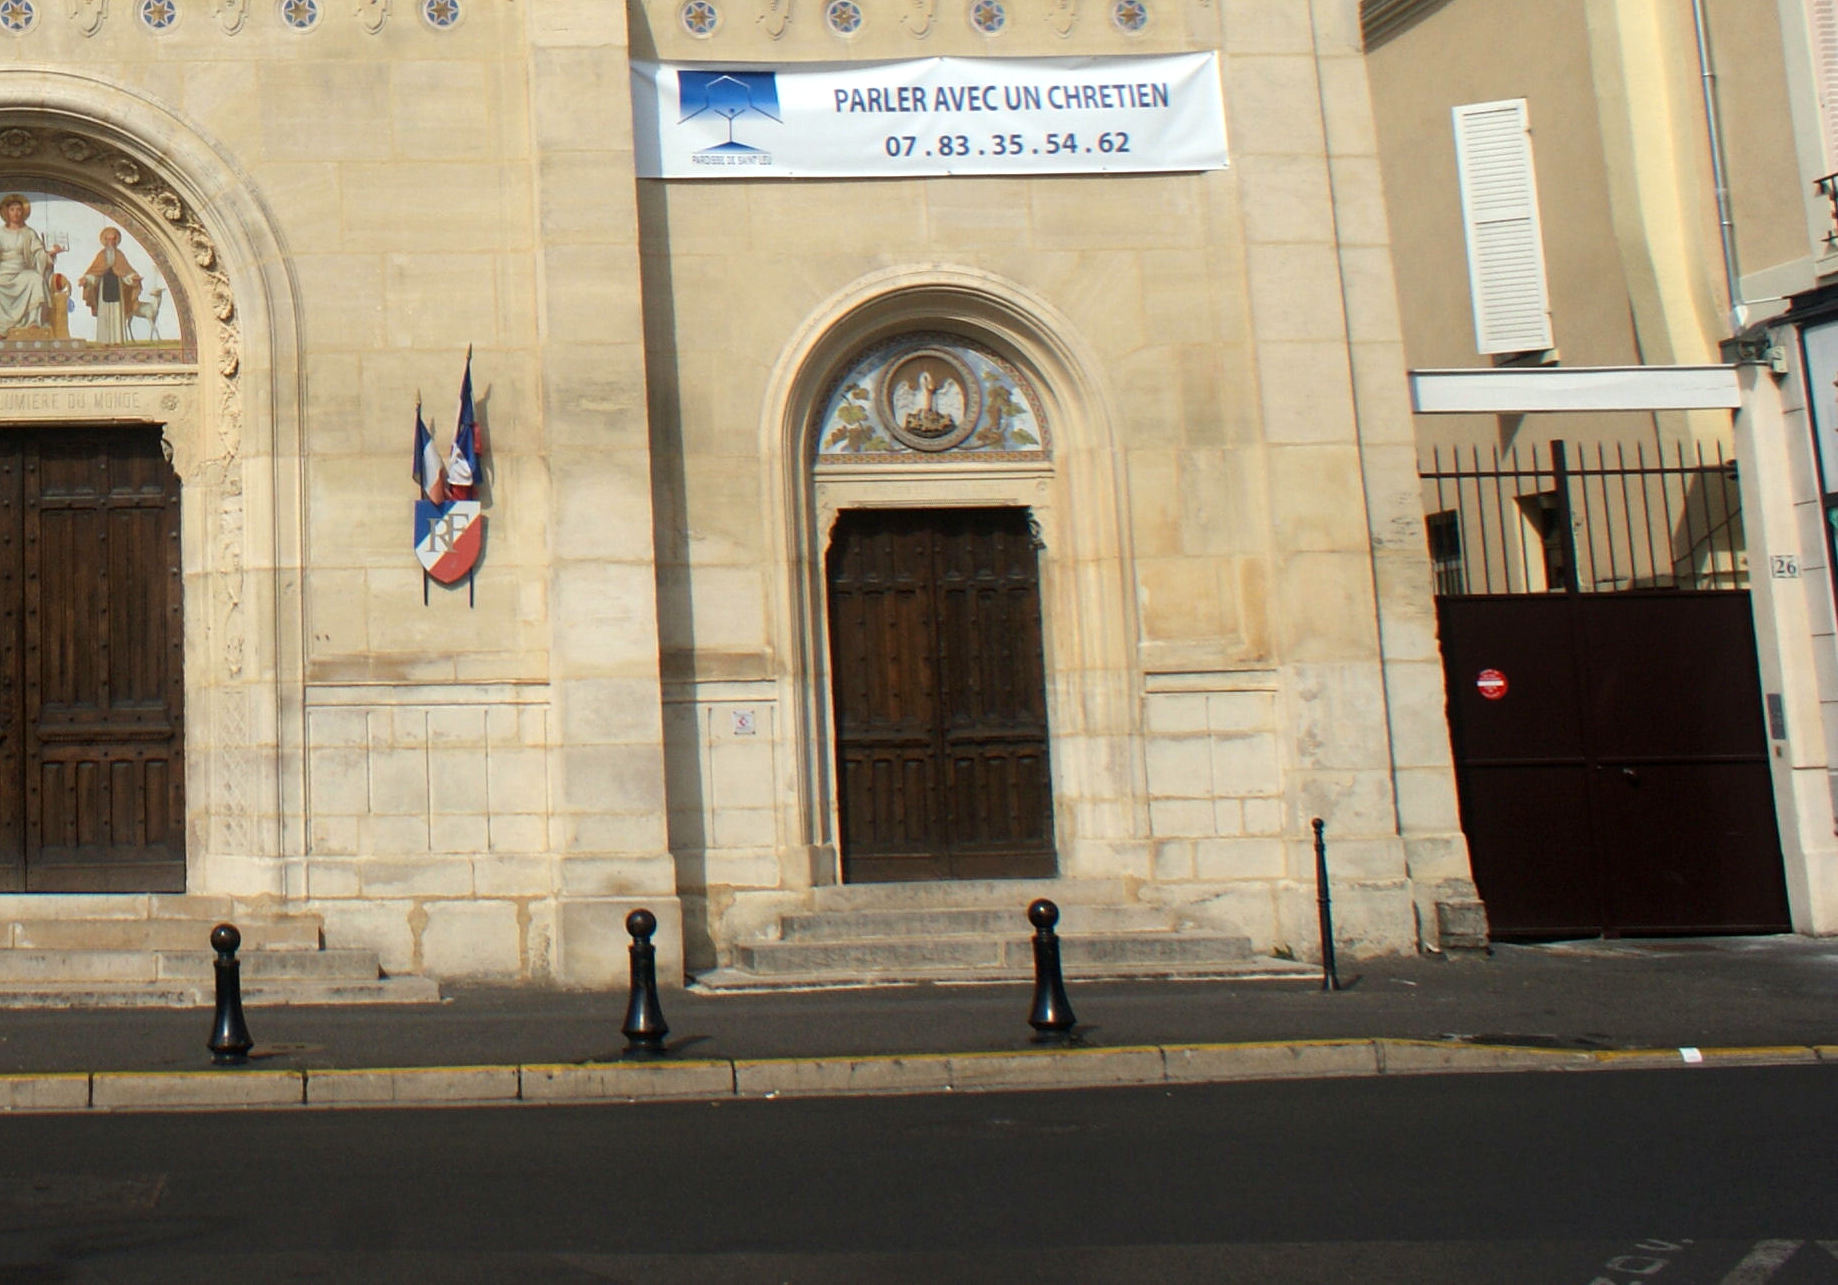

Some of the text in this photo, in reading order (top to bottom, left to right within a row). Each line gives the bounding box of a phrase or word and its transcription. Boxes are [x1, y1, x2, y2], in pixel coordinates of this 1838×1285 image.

[833, 82, 1169, 113] PARLER AVEC UN CHRETIEN
[67, 392, 85, 410] DU
[94, 391, 141, 410] MONDE
[1775, 558, 1797, 575] 26
